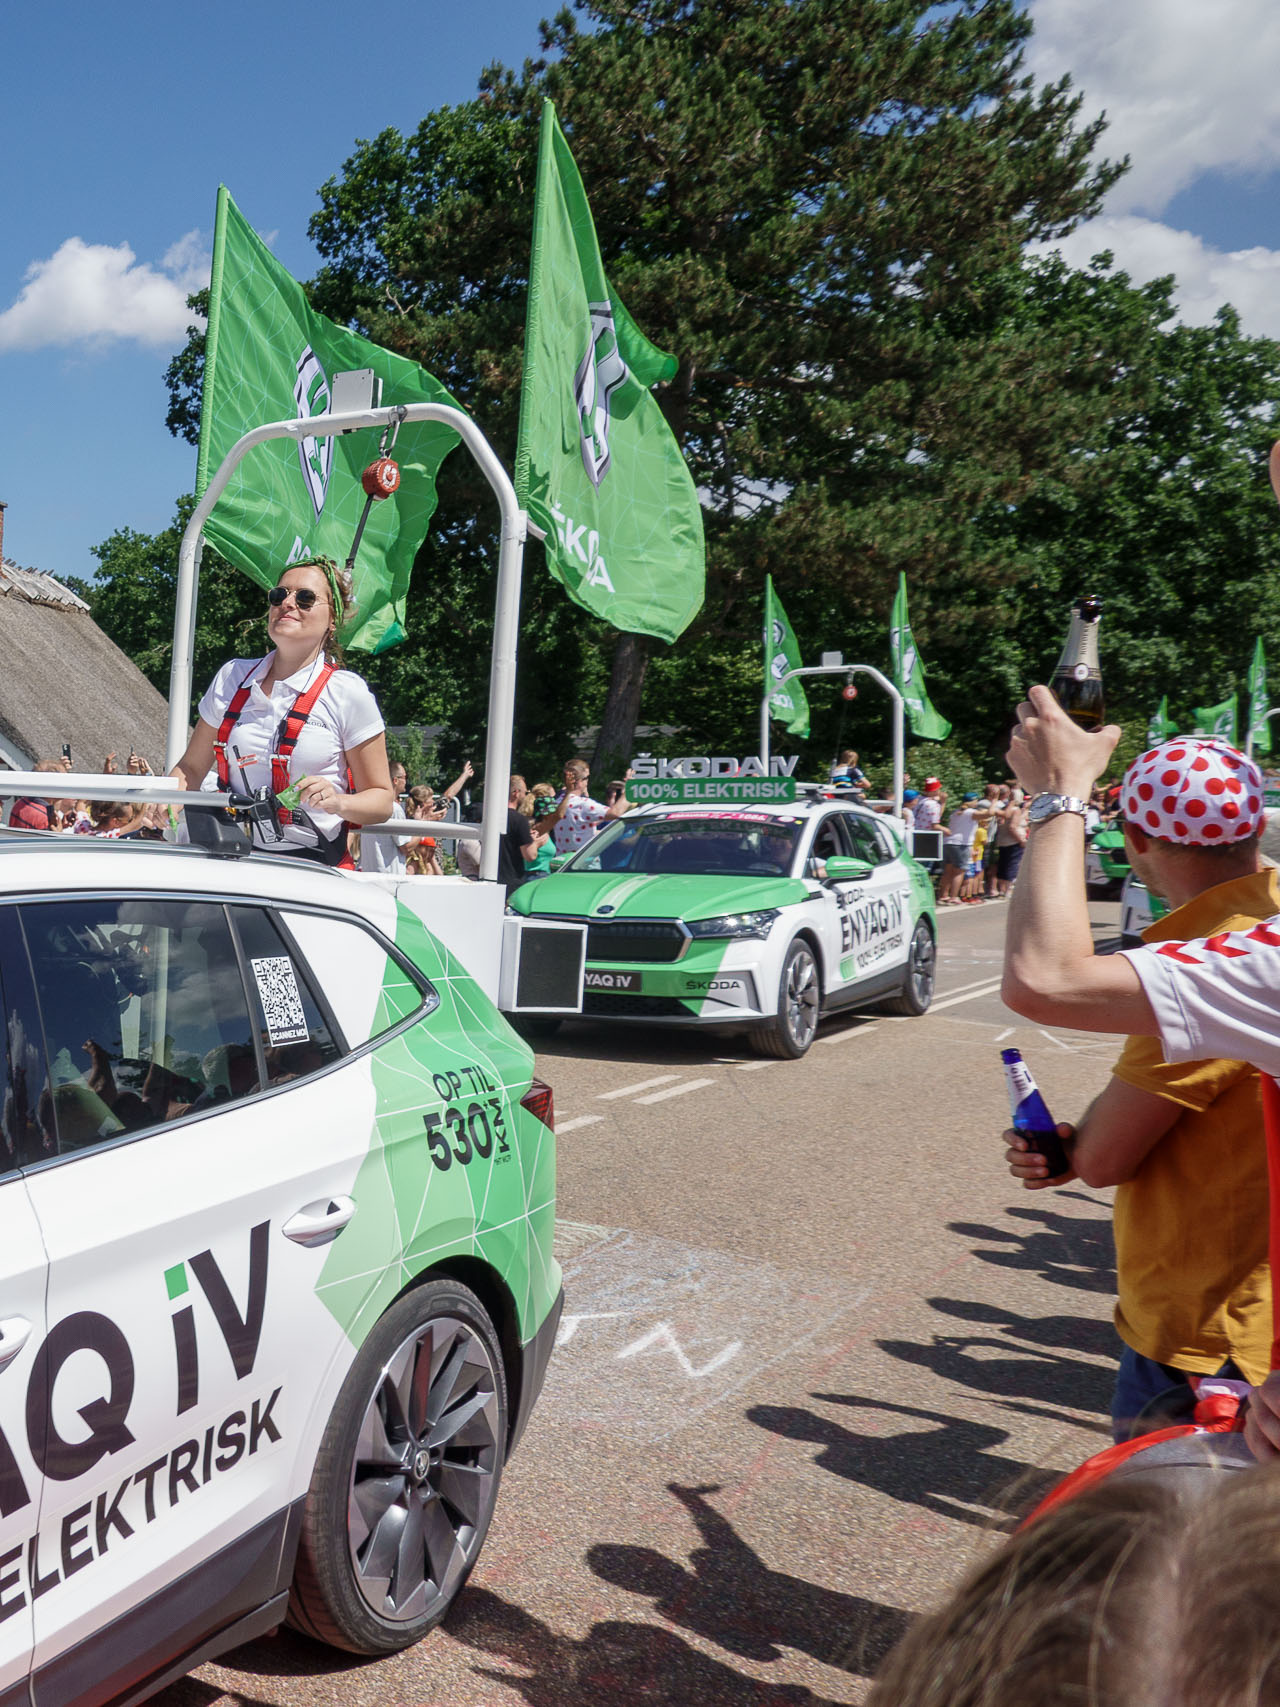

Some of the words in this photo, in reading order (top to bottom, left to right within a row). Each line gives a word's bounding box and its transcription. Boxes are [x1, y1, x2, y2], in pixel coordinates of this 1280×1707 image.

[630, 752, 768, 780] ŠKODA
[630, 783, 679, 799] 100%
[683, 782, 789, 799] ELEKTRISK
[840, 898, 889, 954] ENYAQ
[889, 889, 902, 929] iV
[615, 975, 633, 988] iV
[271, 1030, 297, 1041] SCANNEZ
[432, 1071, 461, 1101] OP
[461, 1064, 495, 1096] TIL
[422, 1102, 492, 1172] 530
[487, 1097, 511, 1153] KM
[163, 1219, 271, 1417] iV
